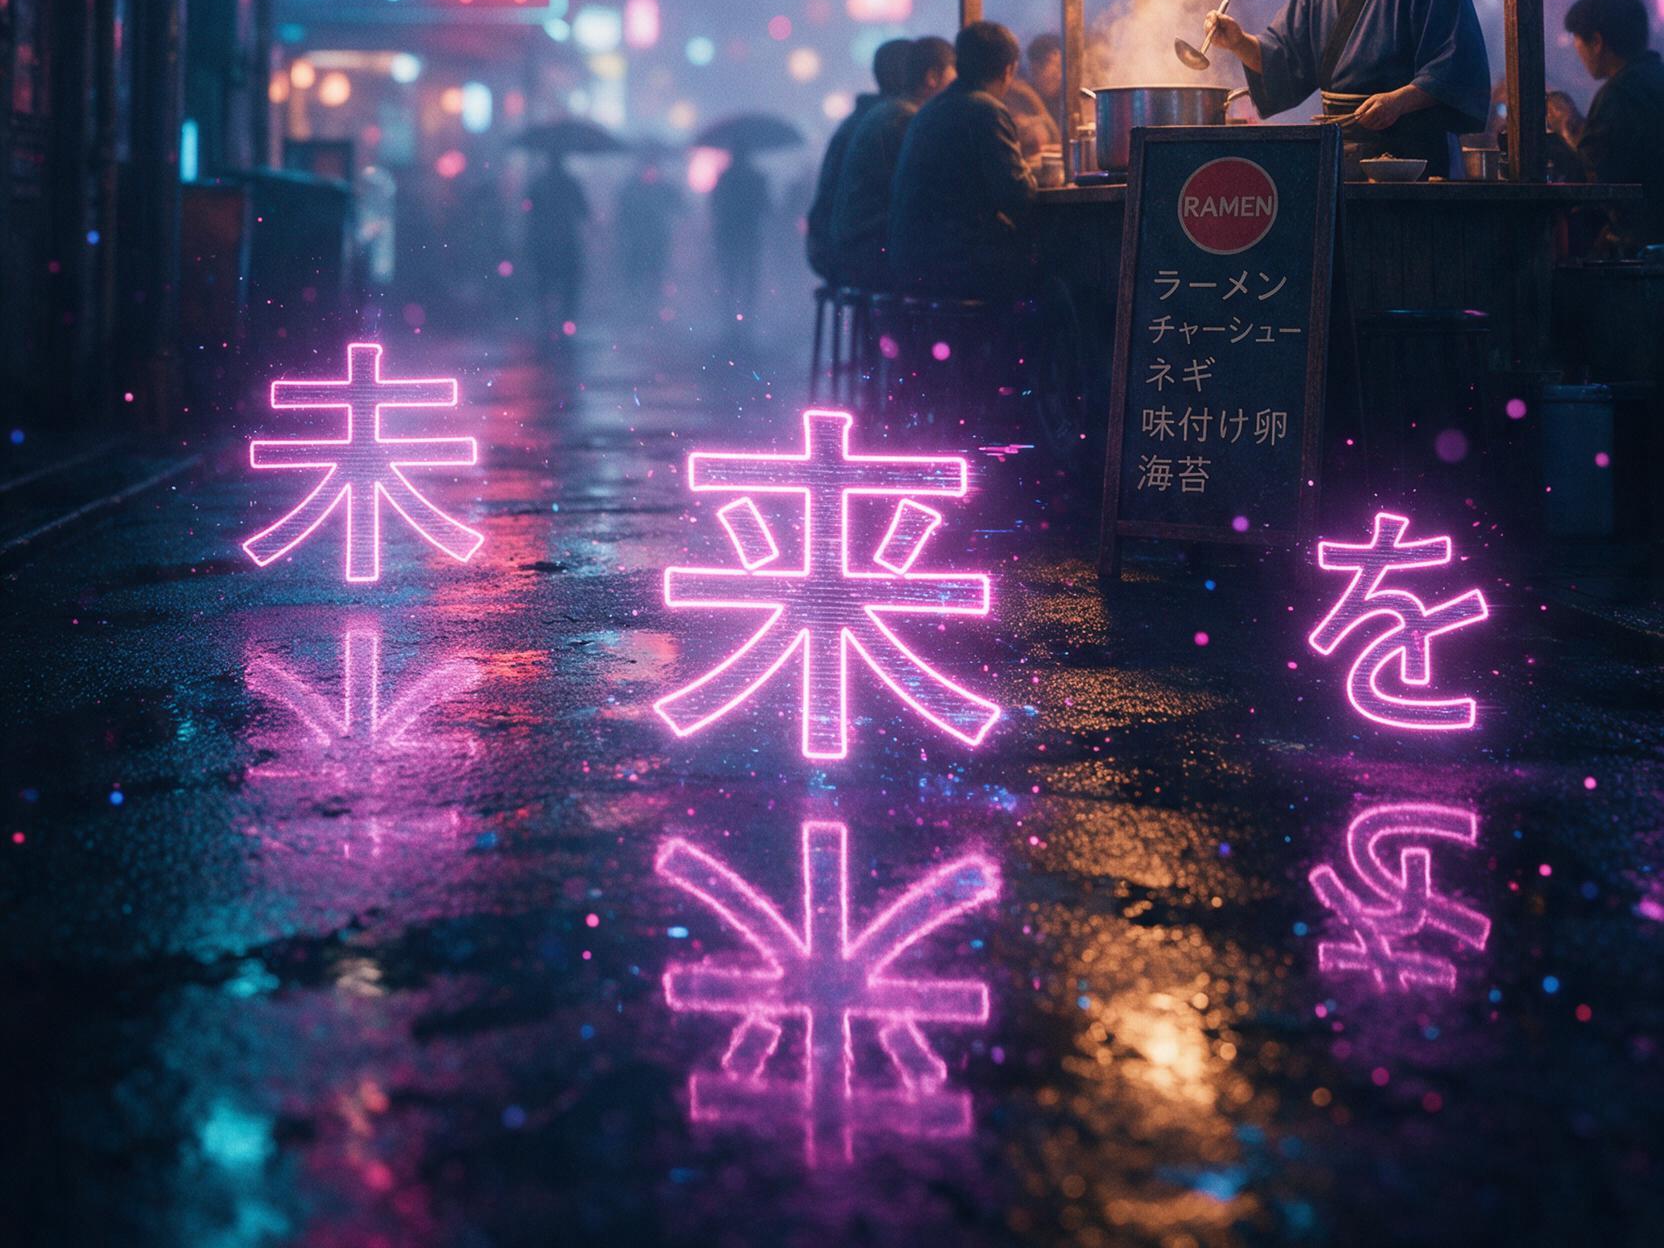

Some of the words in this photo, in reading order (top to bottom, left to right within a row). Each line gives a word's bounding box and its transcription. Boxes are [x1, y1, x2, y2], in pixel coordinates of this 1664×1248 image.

[1183, 195, 1273, 218] RAMEN
[1153, 270, 1288, 301] ラーメン
[1148, 315, 1302, 345] チャーシュー
[1145, 357, 1216, 393] ネギ
[1141, 405, 1288, 446] 味付け卵
[1137, 454, 1212, 493] 海苔
